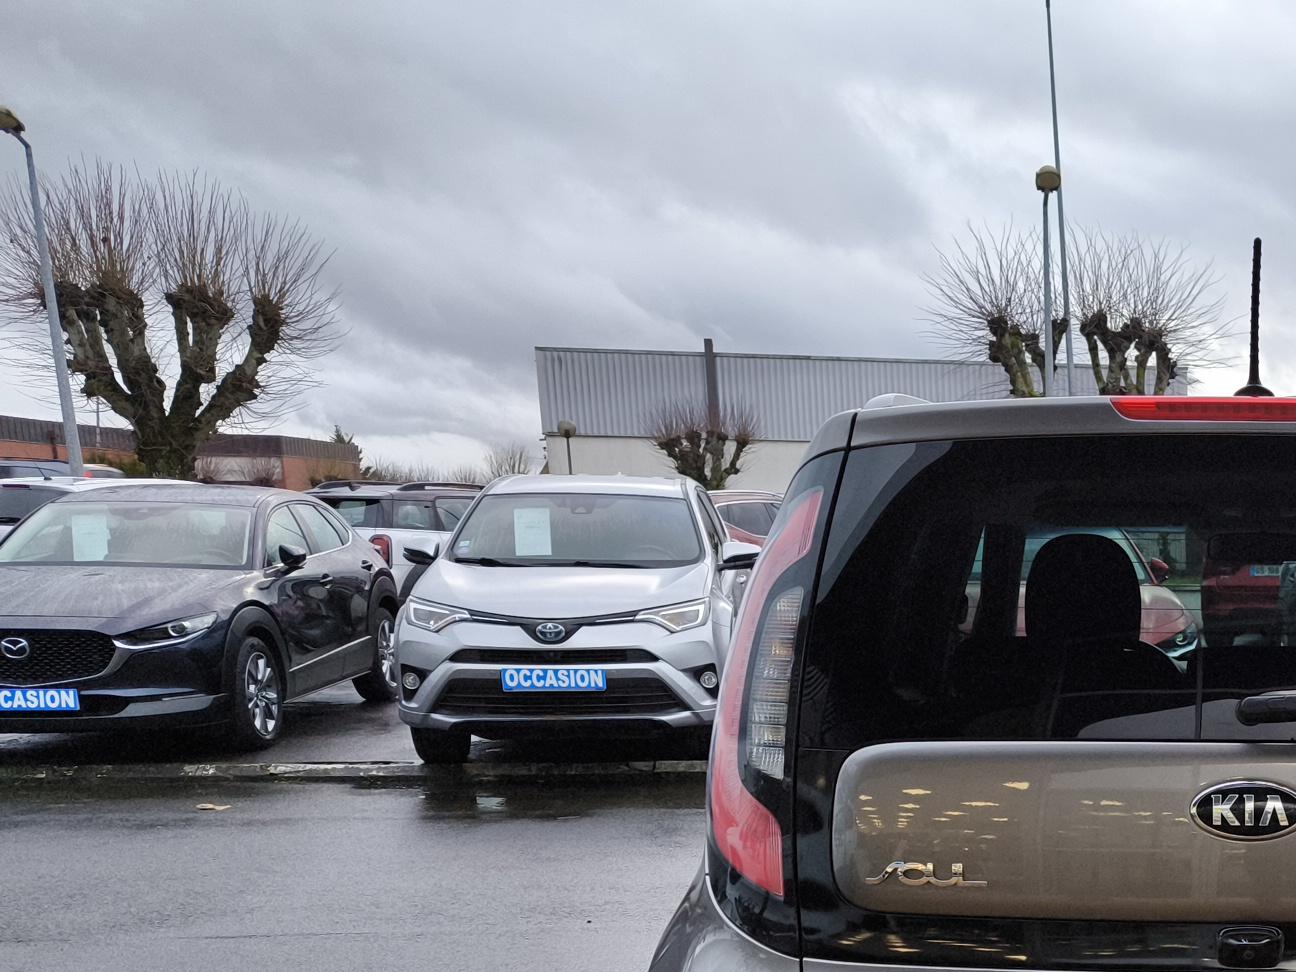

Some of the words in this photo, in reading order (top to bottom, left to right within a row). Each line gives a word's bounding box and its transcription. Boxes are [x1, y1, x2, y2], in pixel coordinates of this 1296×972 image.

[505, 669, 603, 687] OCCASION
[0, 690, 75, 708] CASION
[1211, 794, 1289, 826] KIA
[864, 861, 988, 887] SOUL
